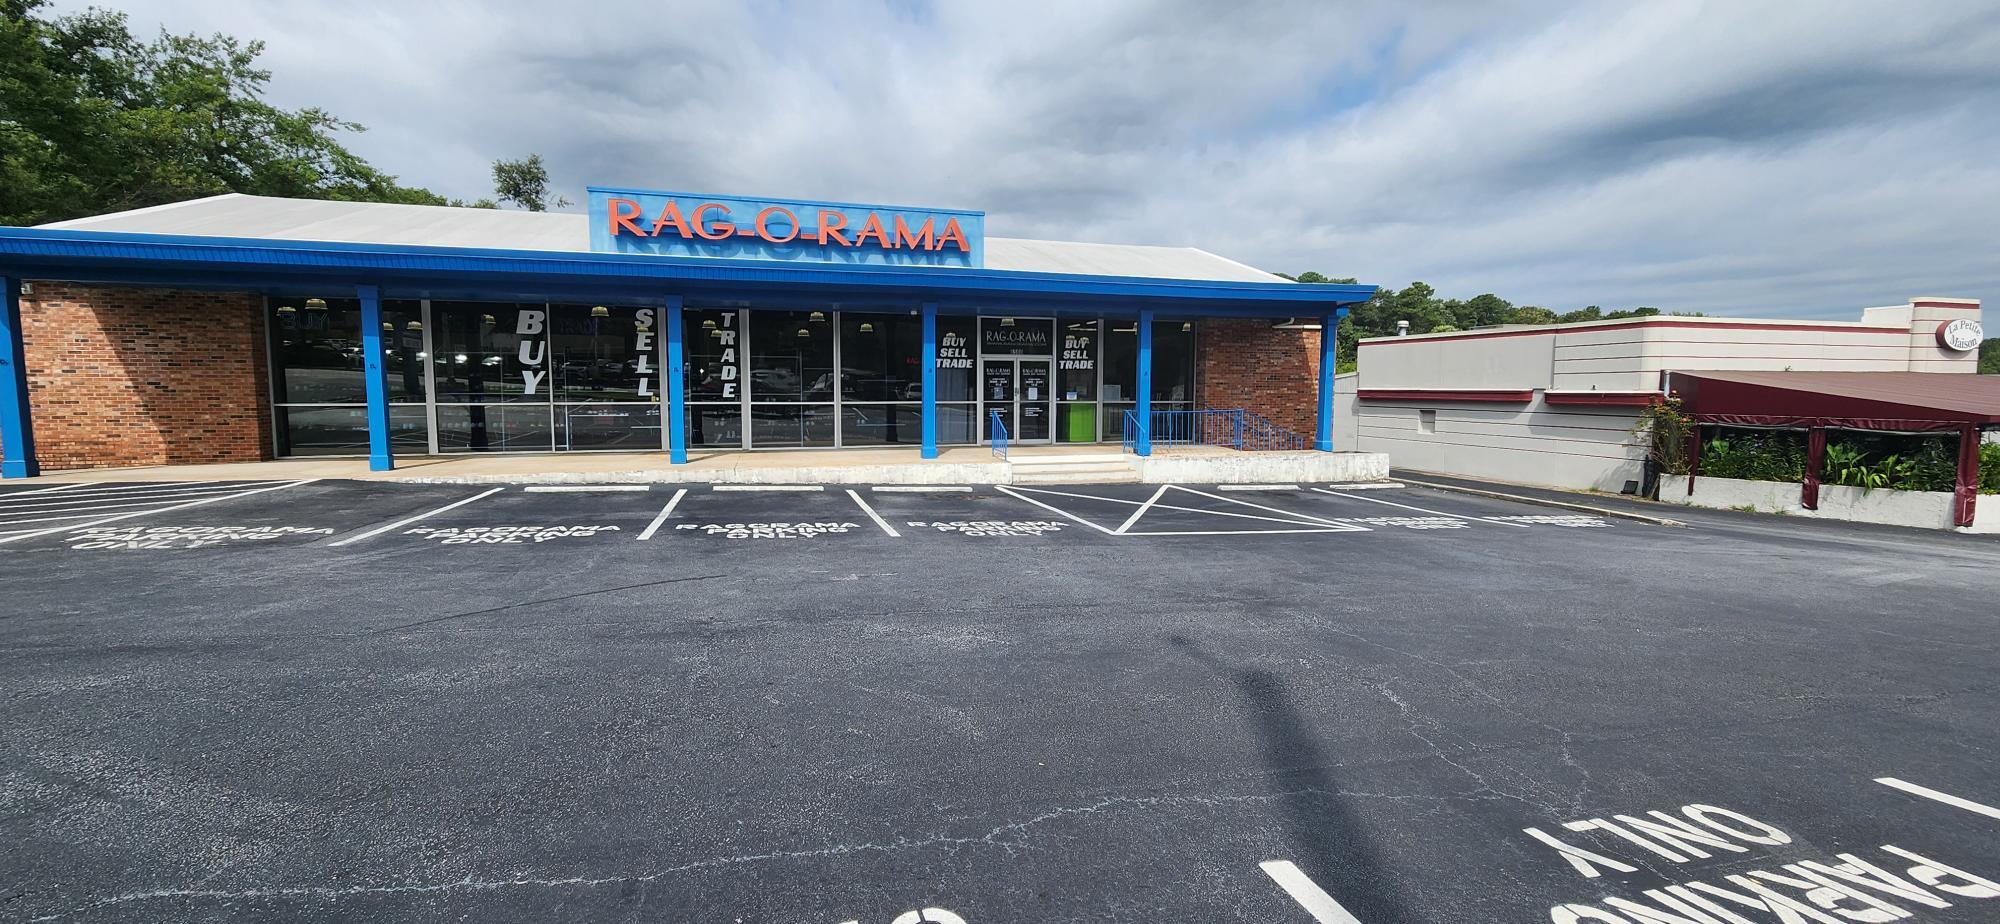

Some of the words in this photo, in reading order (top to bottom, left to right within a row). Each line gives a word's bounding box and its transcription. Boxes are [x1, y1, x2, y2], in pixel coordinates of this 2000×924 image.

[1949, 324, 1958, 334] La
[1960, 320, 1981, 336] Petite
[942, 337, 966, 347] BUY
[1064, 339, 1087, 349] BUY
[1950, 335, 1977, 348] Maison
[516, 310, 546, 395] BUY
[635, 309, 653, 397] SELL
[721, 312, 735, 398] TRADE
[940, 348, 968, 358] SELL
[1063, 350, 1088, 360] SELL
[936, 358, 974, 369] TRADE
[1059, 360, 1094, 370] TRADE
[402, 525, 621, 534] RAGORAMA
[675, 522, 861, 530] RAGORAMA
[1522, 803, 1792, 878] ONLY
